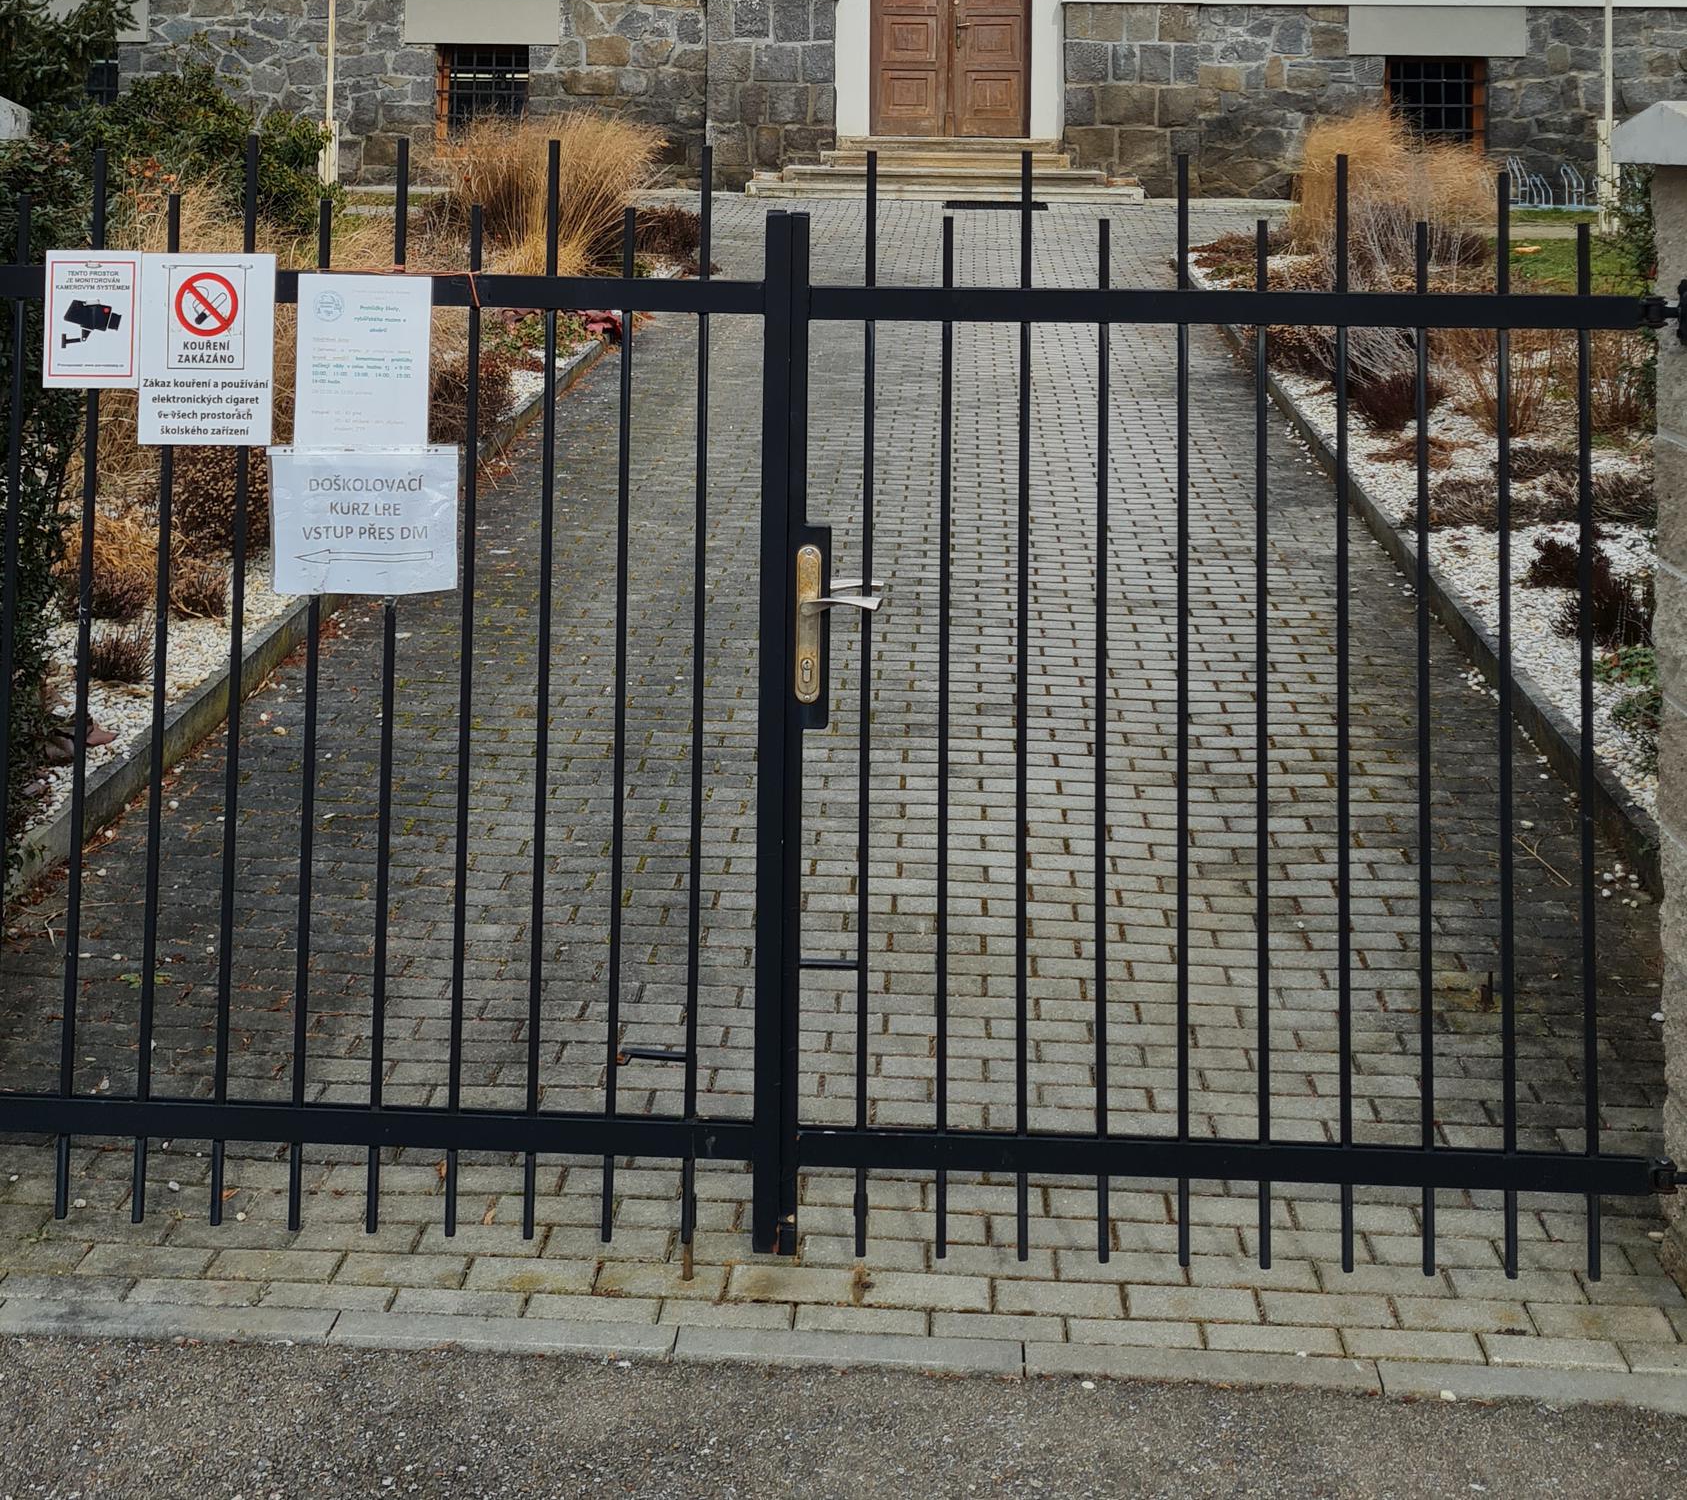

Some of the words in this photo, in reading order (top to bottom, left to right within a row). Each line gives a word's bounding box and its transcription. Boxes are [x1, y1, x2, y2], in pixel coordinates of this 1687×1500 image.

[75, 276, 121, 284] MONITOROVÁN
[183, 340, 230, 351] KOUŘENÍ
[177, 352, 235, 364] ZAKÁZÁNO
[143, 378, 172, 388] Zákaz
[173, 378, 211, 389] kouření
[213, 381, 219, 389] a
[221, 379, 269, 391] používání
[151, 394, 223, 406] elektronických
[225, 395, 260, 407] cigaret
[171, 410, 198, 420] všech
[200, 409, 253, 422] prostorách
[160, 425, 209, 436] školského
[210, 426, 249, 436] zařízení
[308, 474, 424, 493] DOŠKOLOVACÍ
[329, 501, 371, 516] KURZ
[302, 525, 354, 541] VSTUP
[358, 523, 395, 541] PŘES
